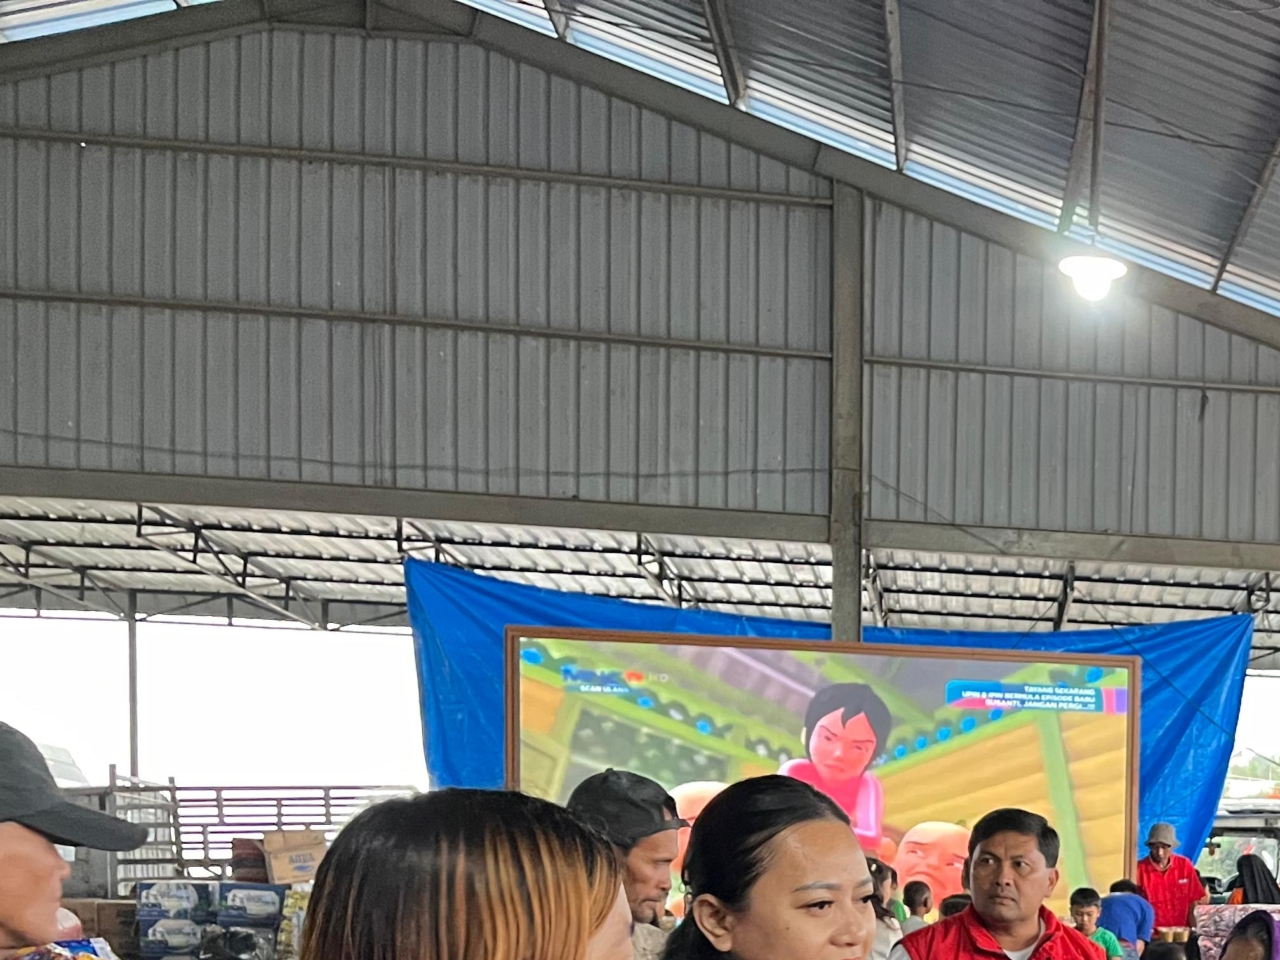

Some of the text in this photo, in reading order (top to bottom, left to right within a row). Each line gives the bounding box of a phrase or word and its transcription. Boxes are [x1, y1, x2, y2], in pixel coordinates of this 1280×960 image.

[1024, 685, 1096, 695] TAYANG SEKARANG
[1004, 693, 1040, 701] BERMULA
[1040, 694, 1073, 702] EPISODE
[1023, 700, 1058, 708] JANGAN
